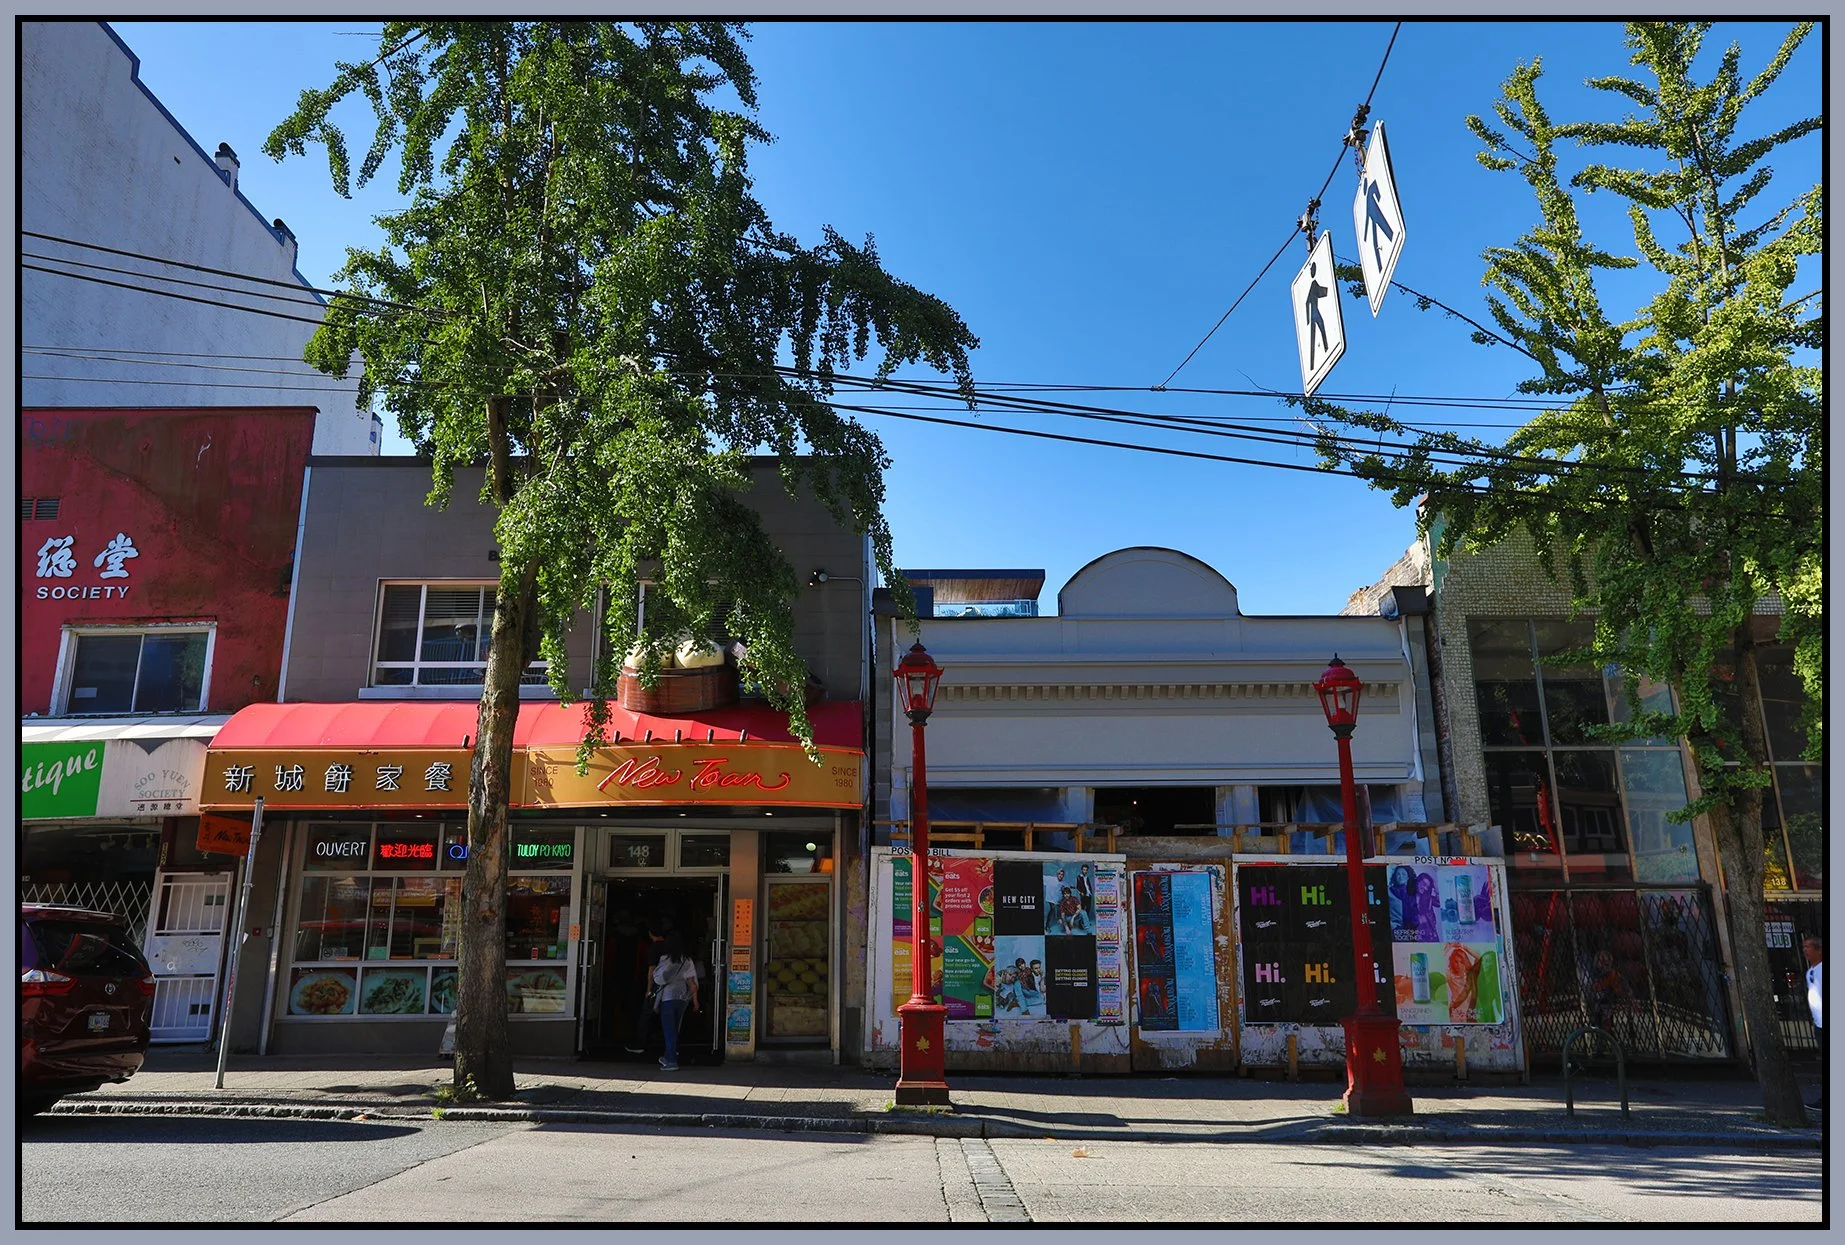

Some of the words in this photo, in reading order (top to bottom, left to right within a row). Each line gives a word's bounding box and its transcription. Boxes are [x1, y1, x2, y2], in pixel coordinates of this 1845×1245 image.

[36, 586, 130, 599] SOCIETY
[530, 765, 558, 775] SINCE
[596, 755, 683, 791] New
[831, 766, 857, 777] SINCE
[134, 772, 156, 791] SOO
[162, 770, 191, 789] YUEN
[533, 777, 555, 787] 1980
[834, 778, 854, 788] 1980
[138, 789, 186, 798] SOCIETY
[315, 840, 367, 857] OUVERT
[380, 843, 433, 858] 歡迎光臨
[517, 844, 539, 857] TULOY
[539, 844, 550, 857] PO
[552, 844, 571, 857] KAYO
[628, 845, 650, 857] 148
[891, 846, 912, 855] POS
[933, 849, 952, 857] BILL
[1414, 856, 1437, 864] POST
[945, 872, 960, 880] eats
[1771, 878, 1786, 887] 138
[1003, 895, 1017, 904] NEW
[1019, 895, 1036, 904] CITY
[1250, 886, 1282, 906] Hi.
[1301, 885, 1332, 905] Hi.
[1366, 884, 1382, 905] i.
[1255, 962, 1287, 983] Hi.
[1304, 962, 1336, 984] Hi.
[1373, 962, 1387, 983] i.
